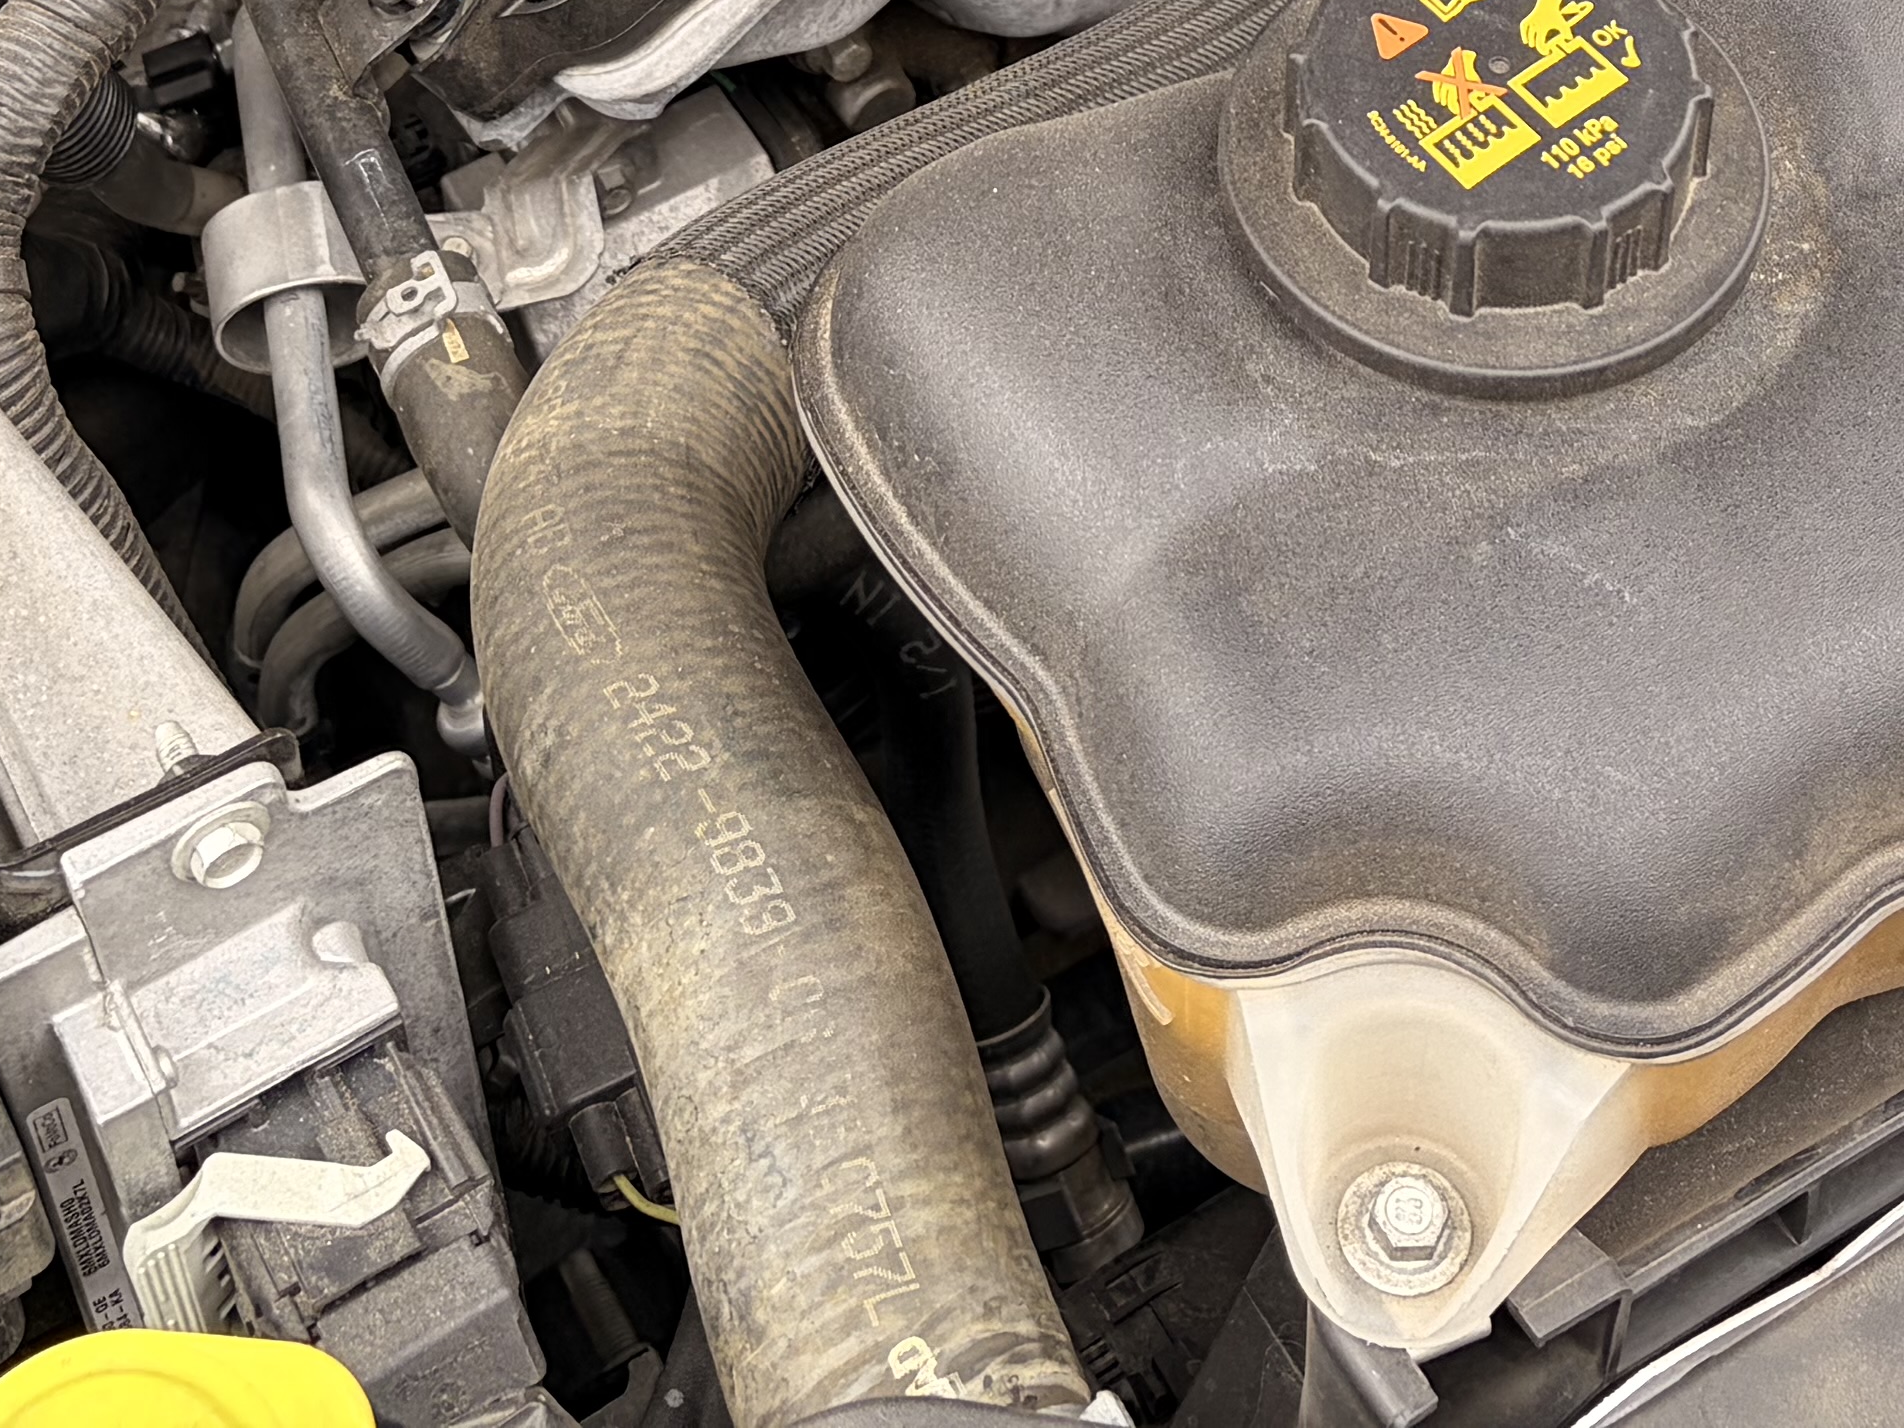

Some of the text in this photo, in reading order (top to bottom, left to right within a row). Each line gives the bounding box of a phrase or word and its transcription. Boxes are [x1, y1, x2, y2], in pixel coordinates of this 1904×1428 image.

[1592, 19, 1629, 48] OK
[1540, 114, 1621, 170] 110 kPa
[1566, 132, 1629, 180] 16 psi
